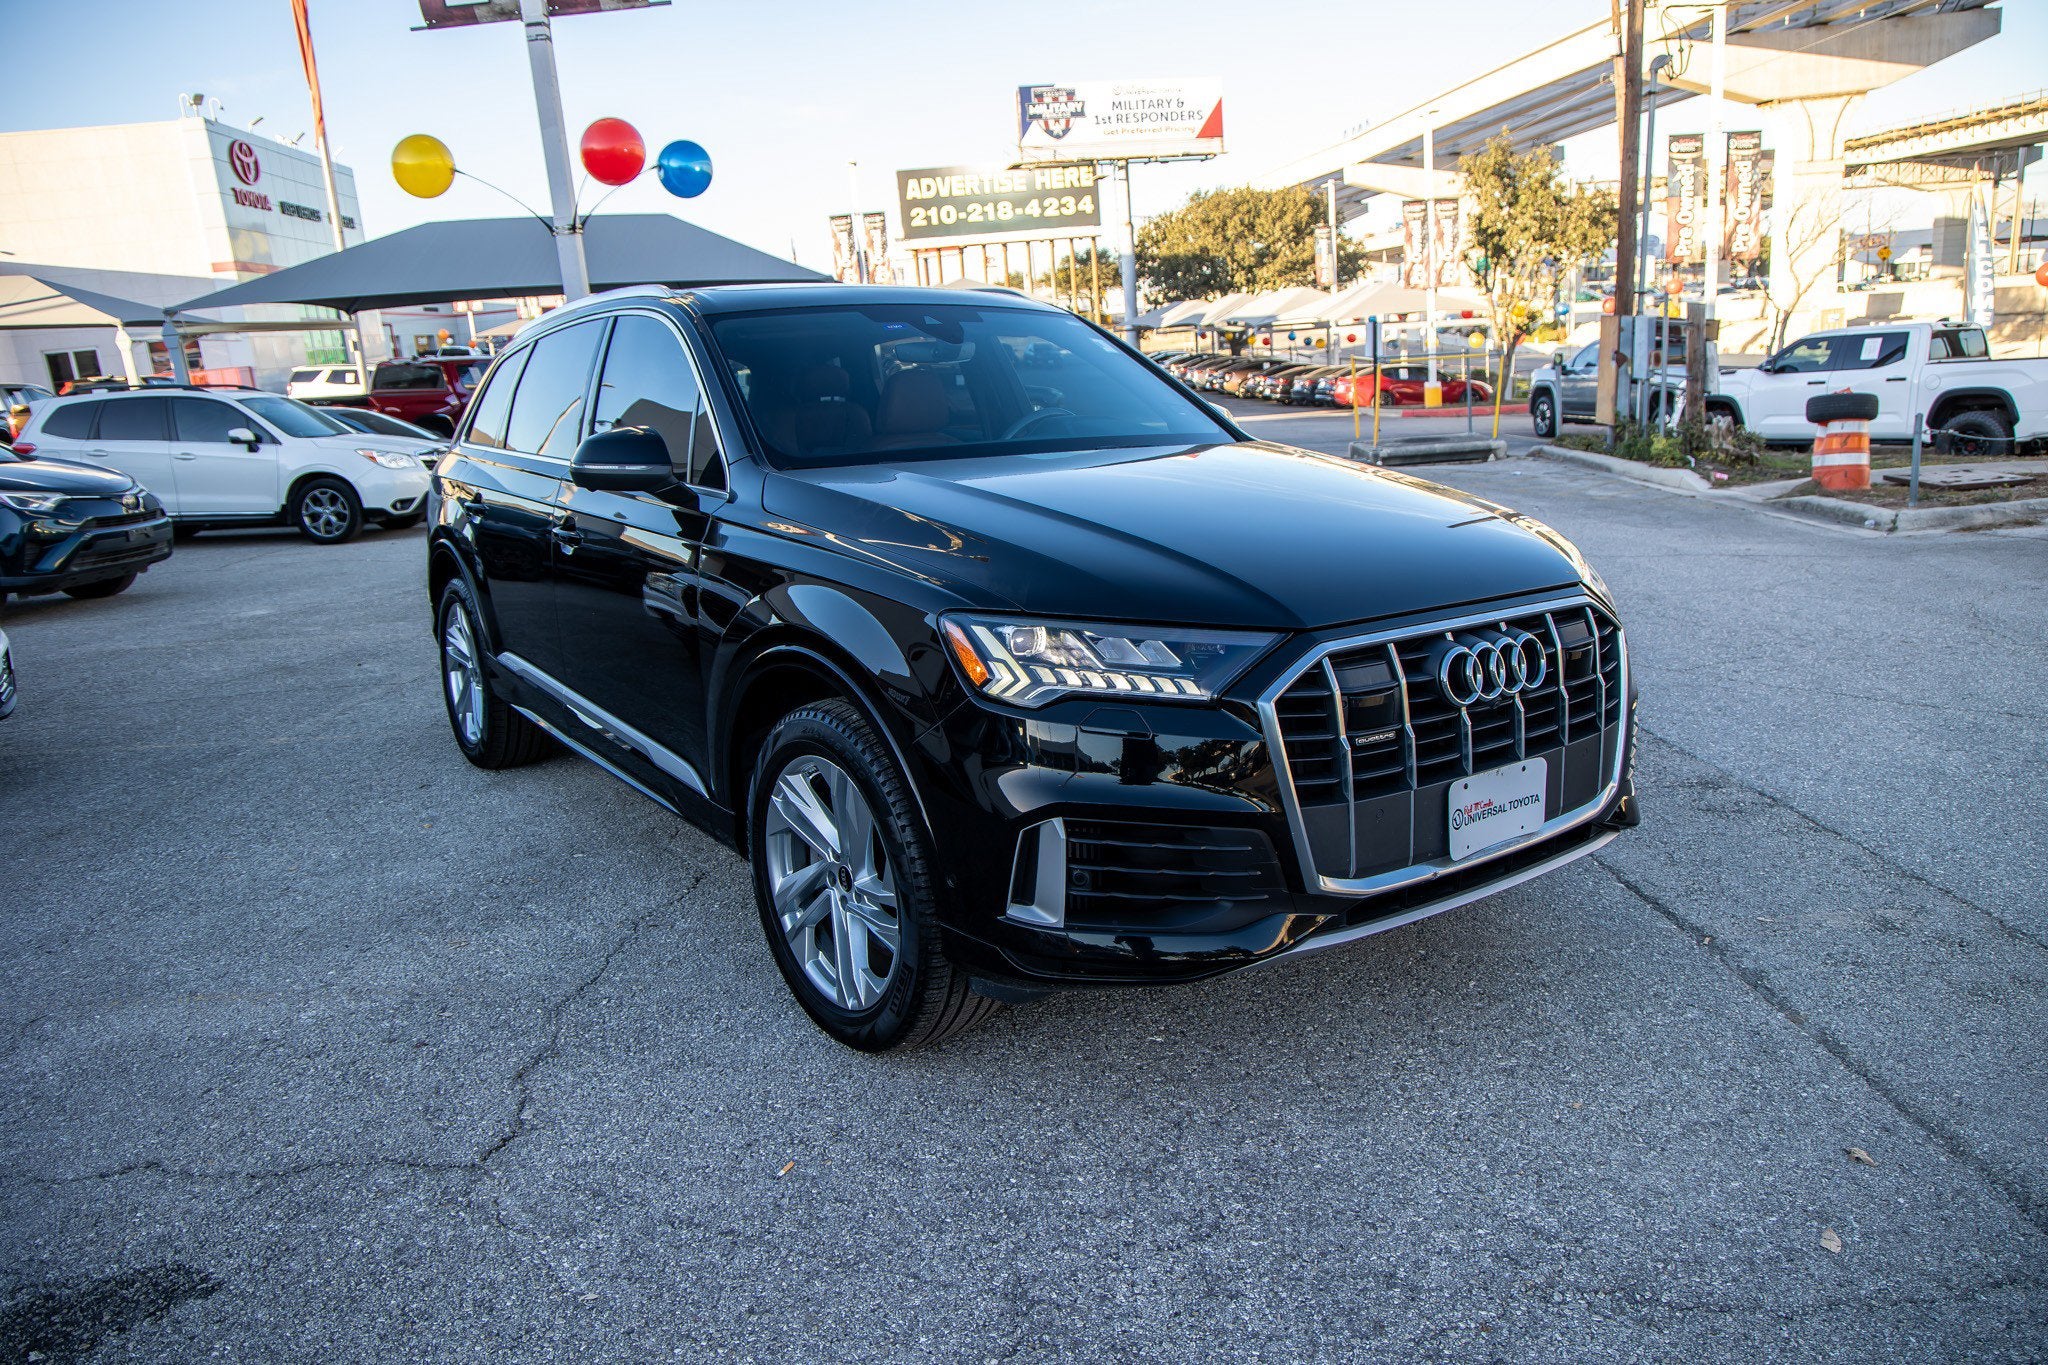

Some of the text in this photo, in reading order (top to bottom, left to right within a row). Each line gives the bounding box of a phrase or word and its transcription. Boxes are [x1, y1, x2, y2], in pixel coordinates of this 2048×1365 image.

[1094, 109, 1203, 125] 1st RESPONDERS
[1111, 97, 1184, 111] MILITARY &
[906, 166, 1094, 200] ADVERTISE HERE
[1675, 163, 1695, 225] Owned
[1733, 160, 1753, 222] Owned
[231, 187, 273, 212] TOYOTA
[909, 195, 1095, 228] 210-218-4234
[1674, 226, 1694, 257] Pre
[1730, 223, 1751, 253] Pre
[1464, 794, 1540, 826] UNIVERSAL TOYOTA
